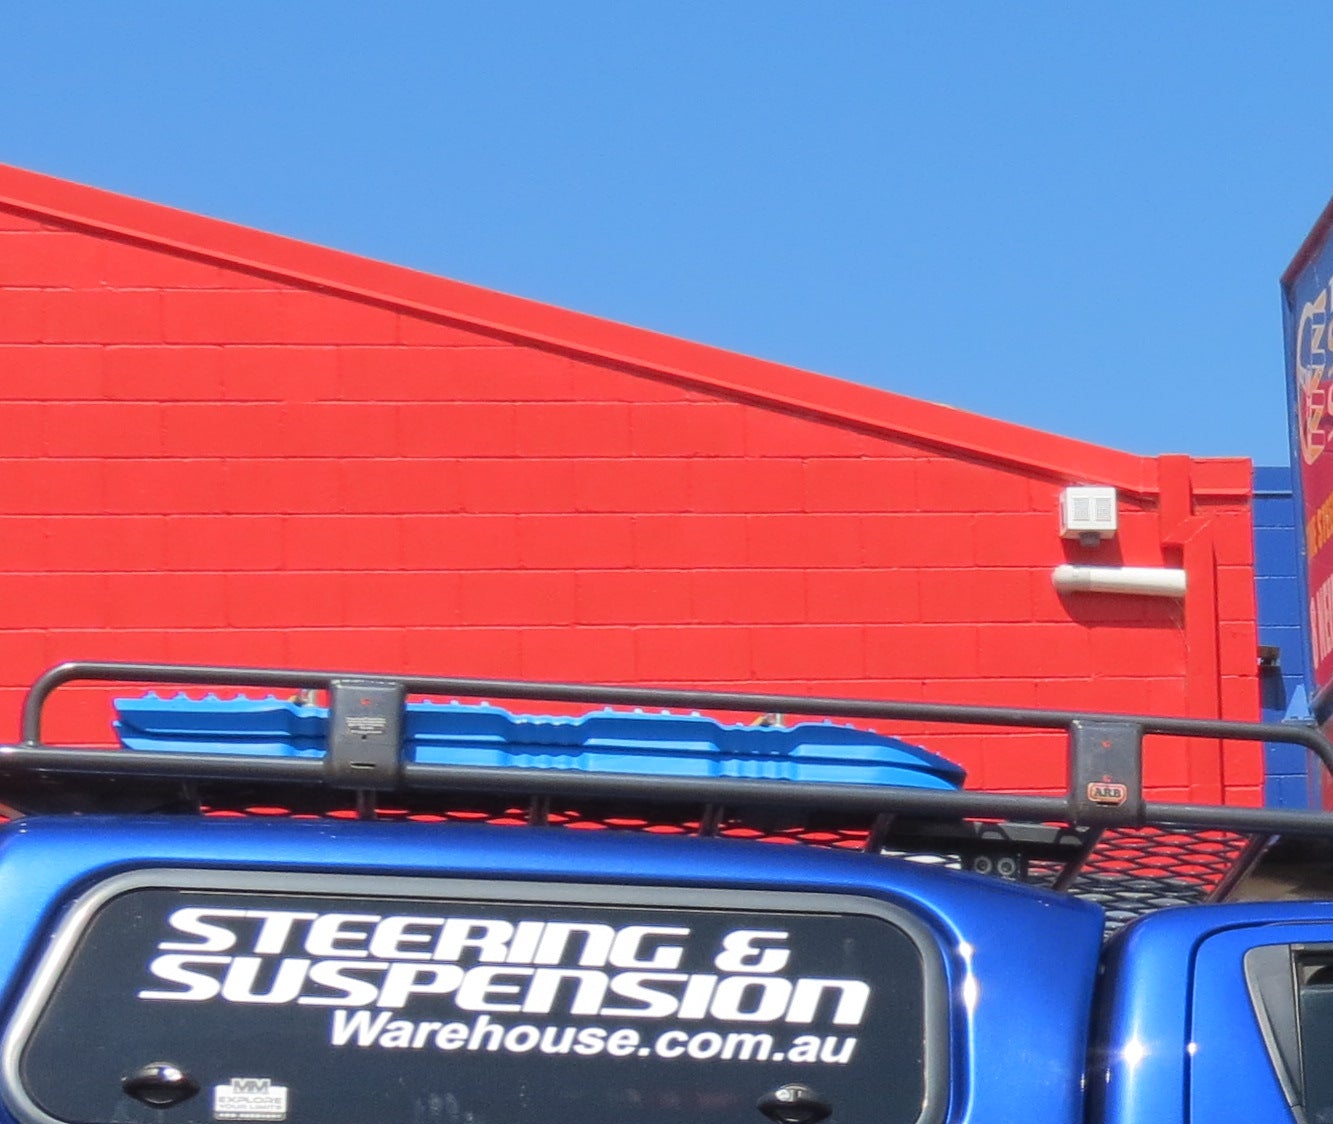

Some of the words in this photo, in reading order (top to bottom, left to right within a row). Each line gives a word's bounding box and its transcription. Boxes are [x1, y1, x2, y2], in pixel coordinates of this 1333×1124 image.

[1094, 787, 1121, 798] ARB
[157, 907, 690, 972] STEERING
[713, 930, 790, 974] &
[138, 954, 871, 1026] SUSPENSION
[331, 1010, 858, 1065] Warehouse.com.au
